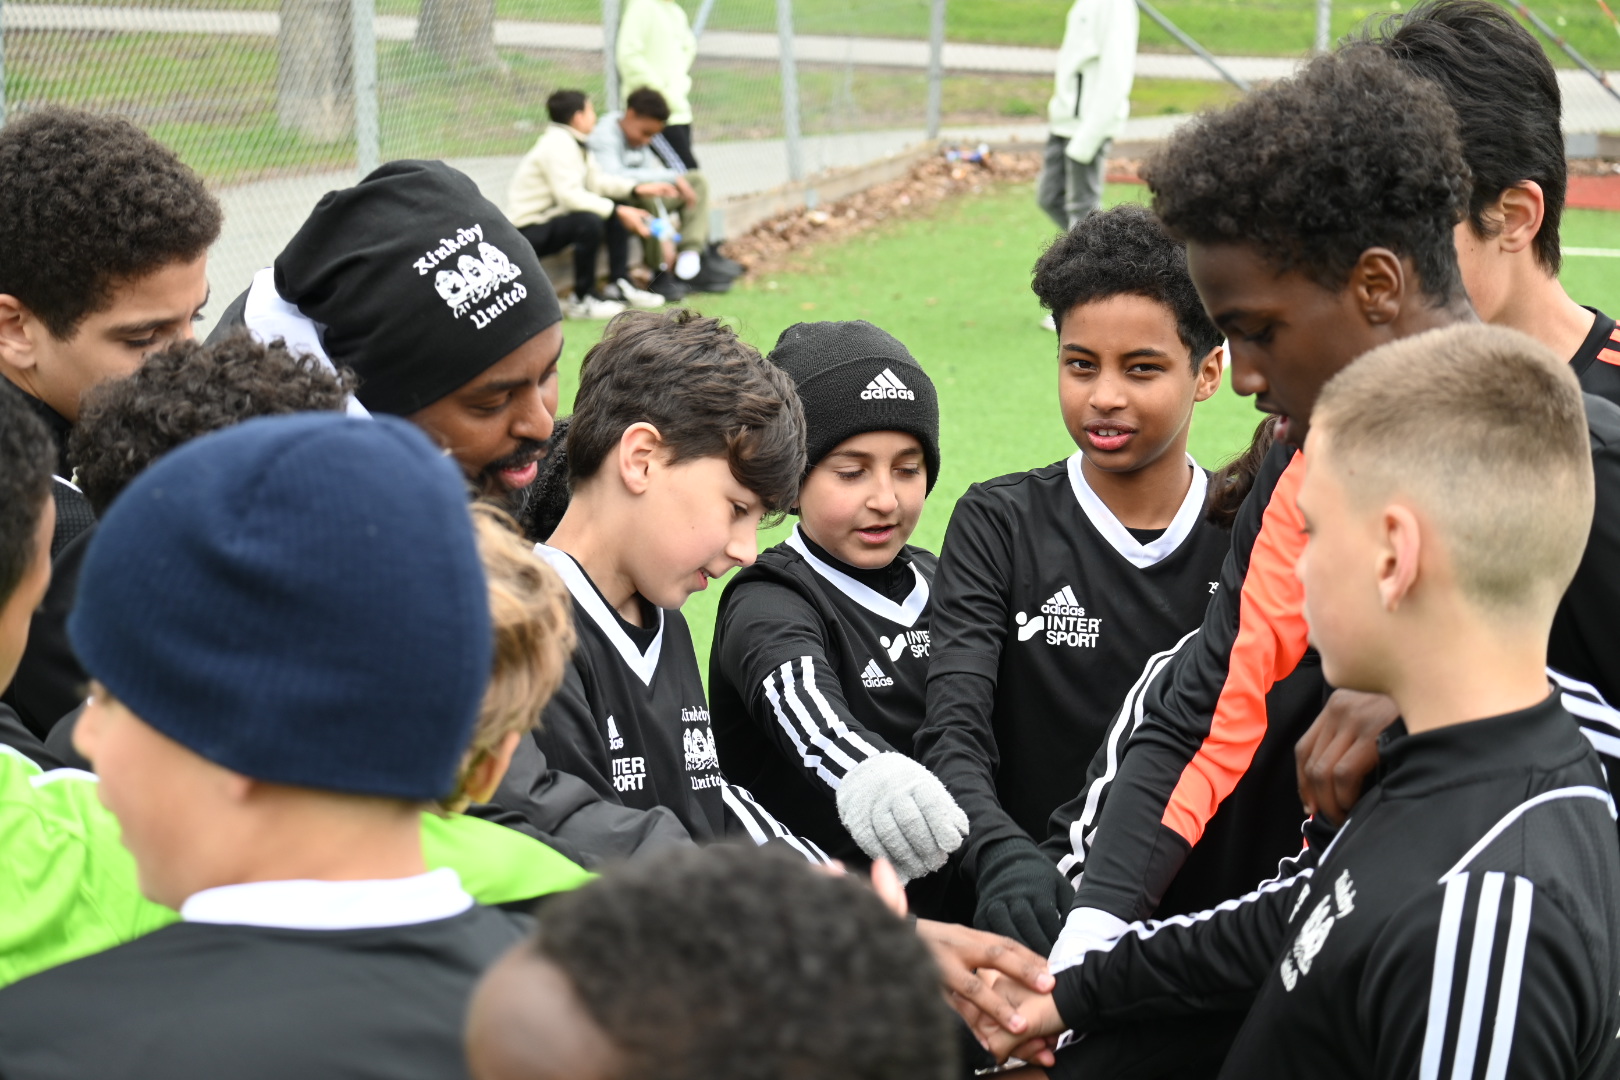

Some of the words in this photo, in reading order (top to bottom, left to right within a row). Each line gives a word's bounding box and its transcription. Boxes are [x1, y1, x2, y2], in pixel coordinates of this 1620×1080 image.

[413, 224, 483, 276] Rinkeby
[469, 282, 527, 330] United
[860, 387, 915, 401] adidas
[1040, 604, 1086, 617] adidas
[1047, 615, 1100, 633] INTER
[906, 630, 931, 645] INTE
[1046, 630, 1100, 648] SPORT
